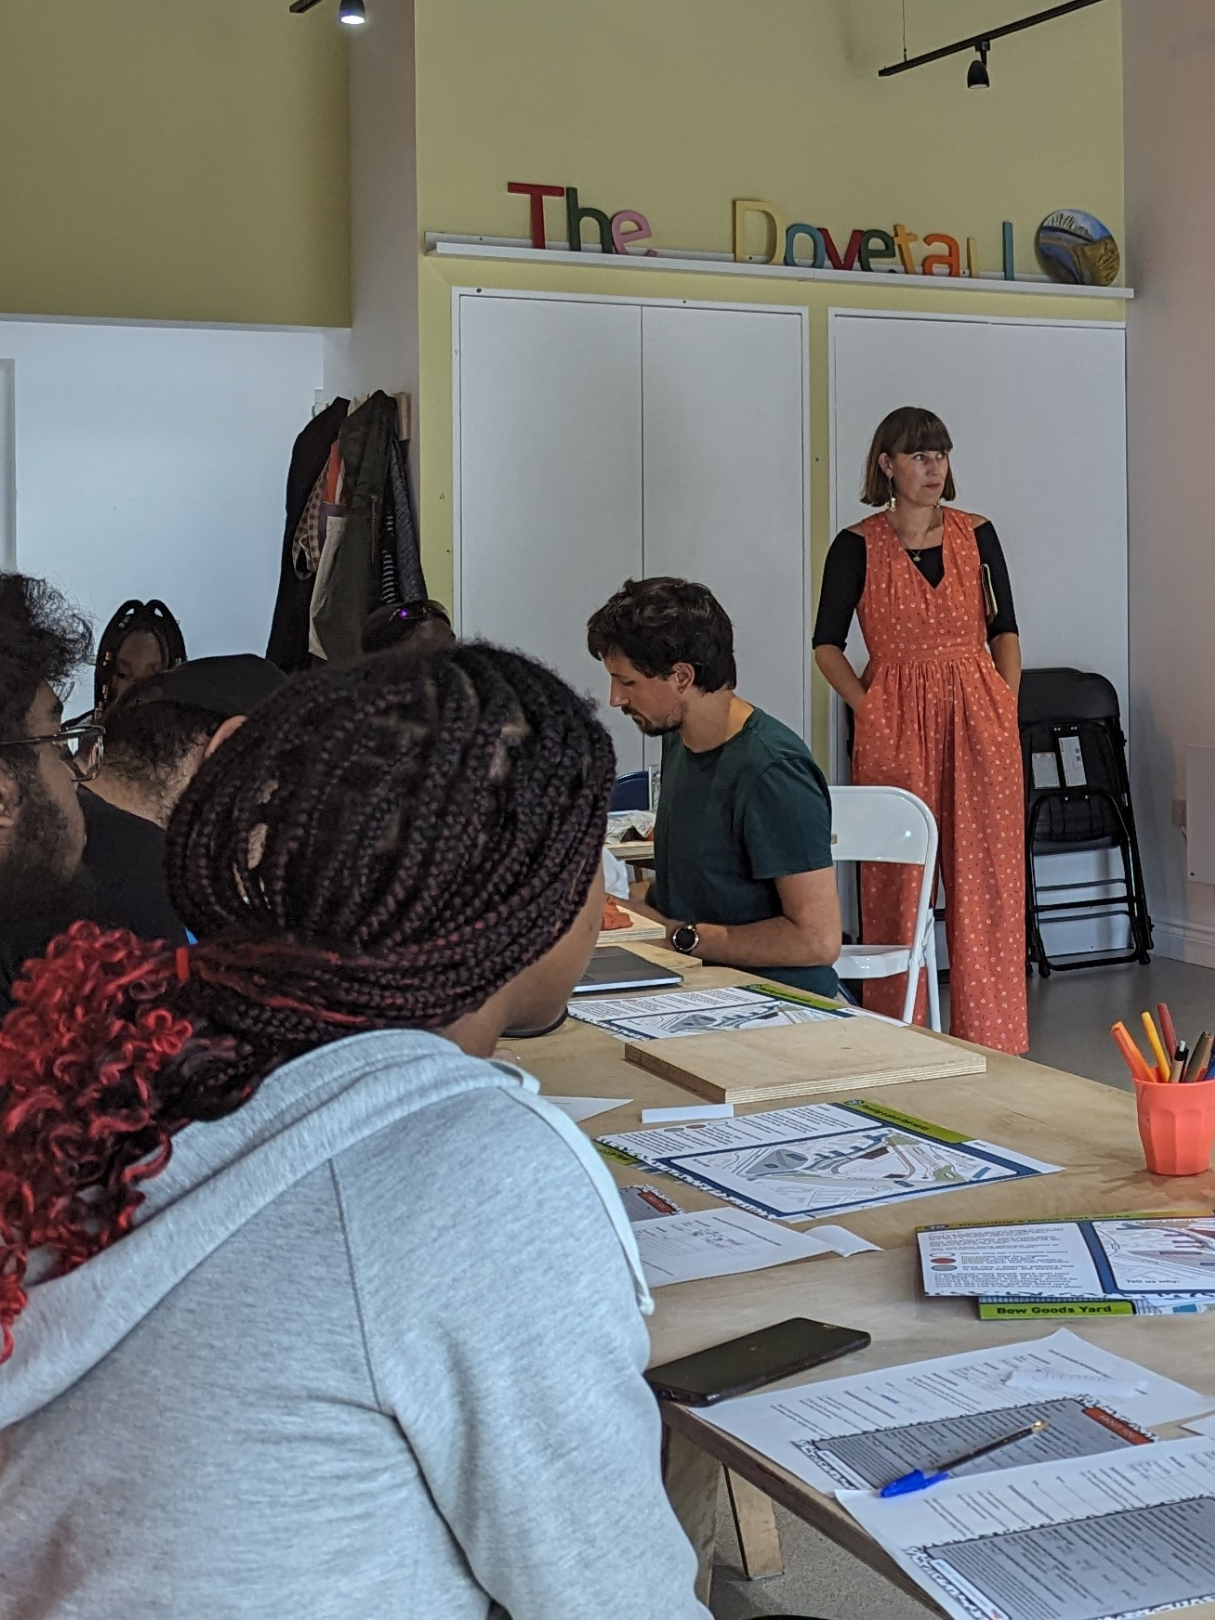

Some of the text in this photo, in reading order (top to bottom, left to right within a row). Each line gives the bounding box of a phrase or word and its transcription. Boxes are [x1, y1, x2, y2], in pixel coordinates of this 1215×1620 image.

[507, 181, 657, 258] The
[996, 1304, 1112, 1315] Bow Goods Yard
